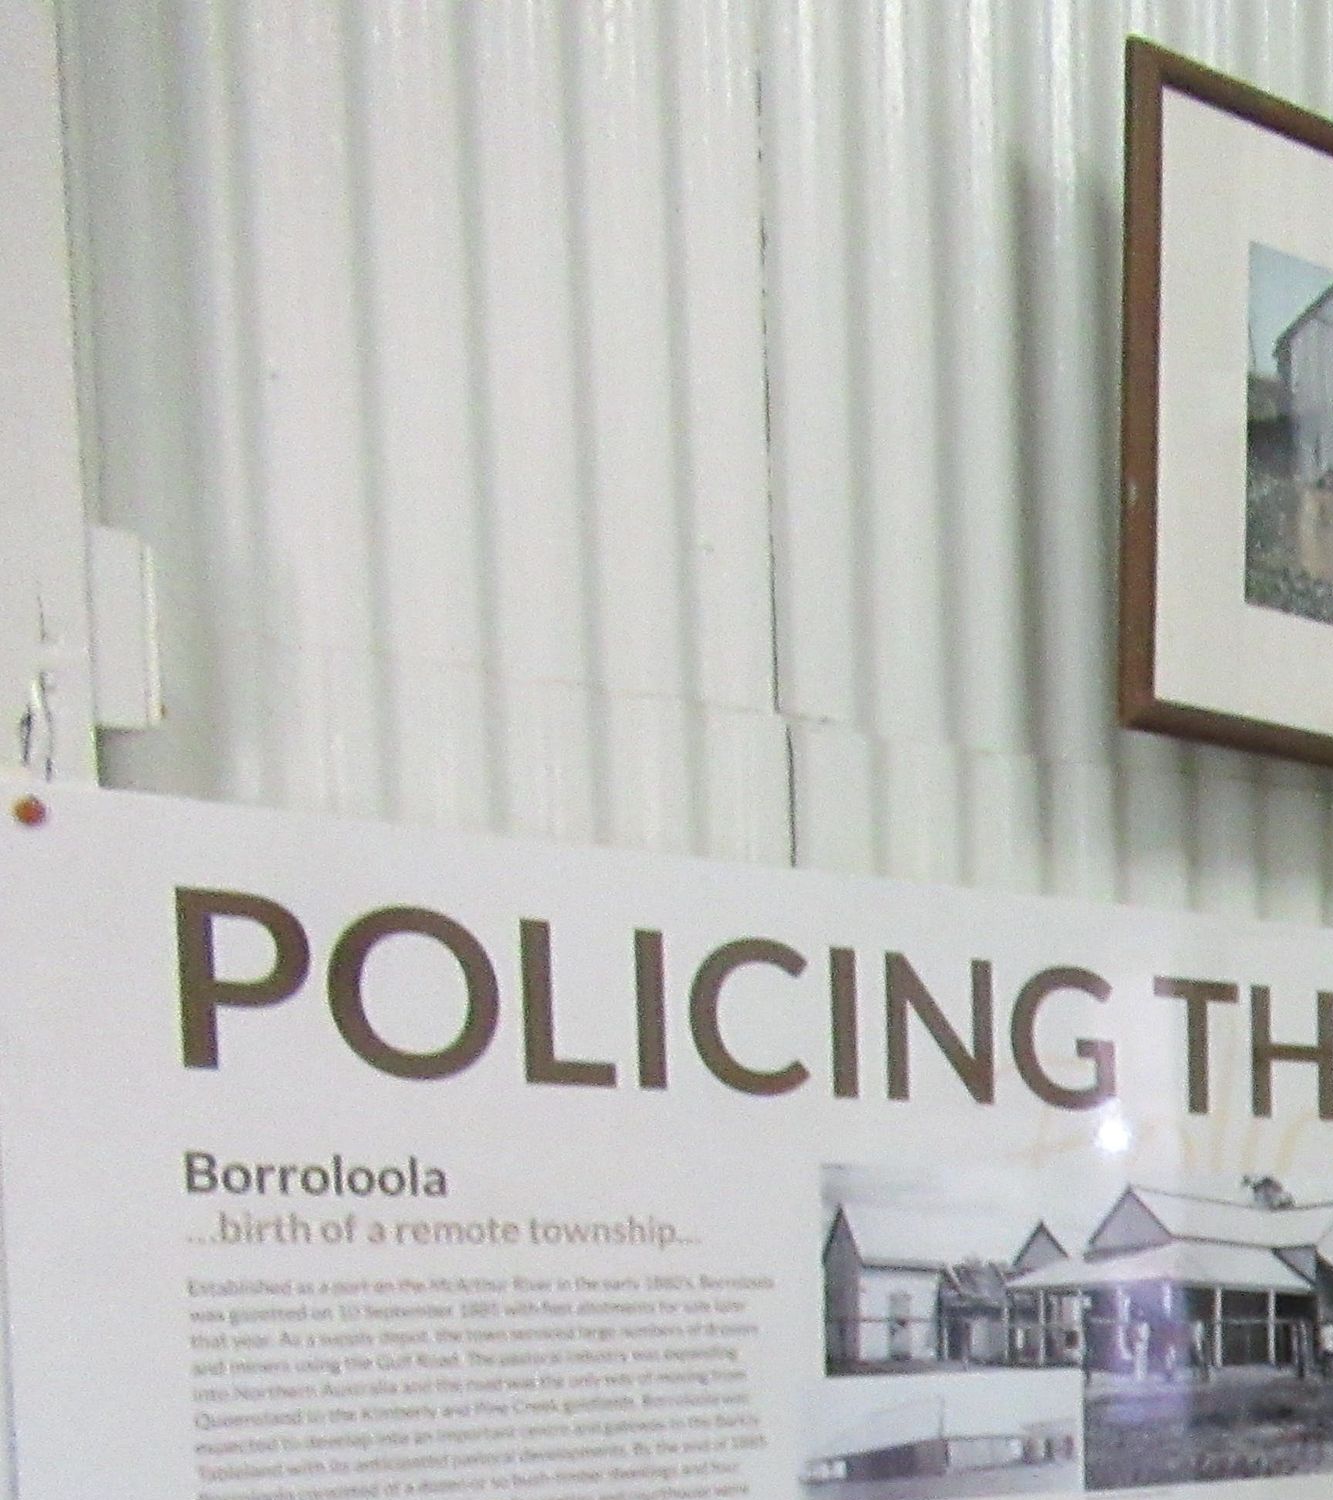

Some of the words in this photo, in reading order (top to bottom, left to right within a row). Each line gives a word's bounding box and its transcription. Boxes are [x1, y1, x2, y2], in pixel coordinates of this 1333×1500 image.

[174, 886, 1117, 1111] POLICING
[183, 1148, 450, 1199] Borroloola
[320, 1213, 357, 1244] of
[367, 1221, 387, 1243] a
[395, 1216, 520, 1245] remote
